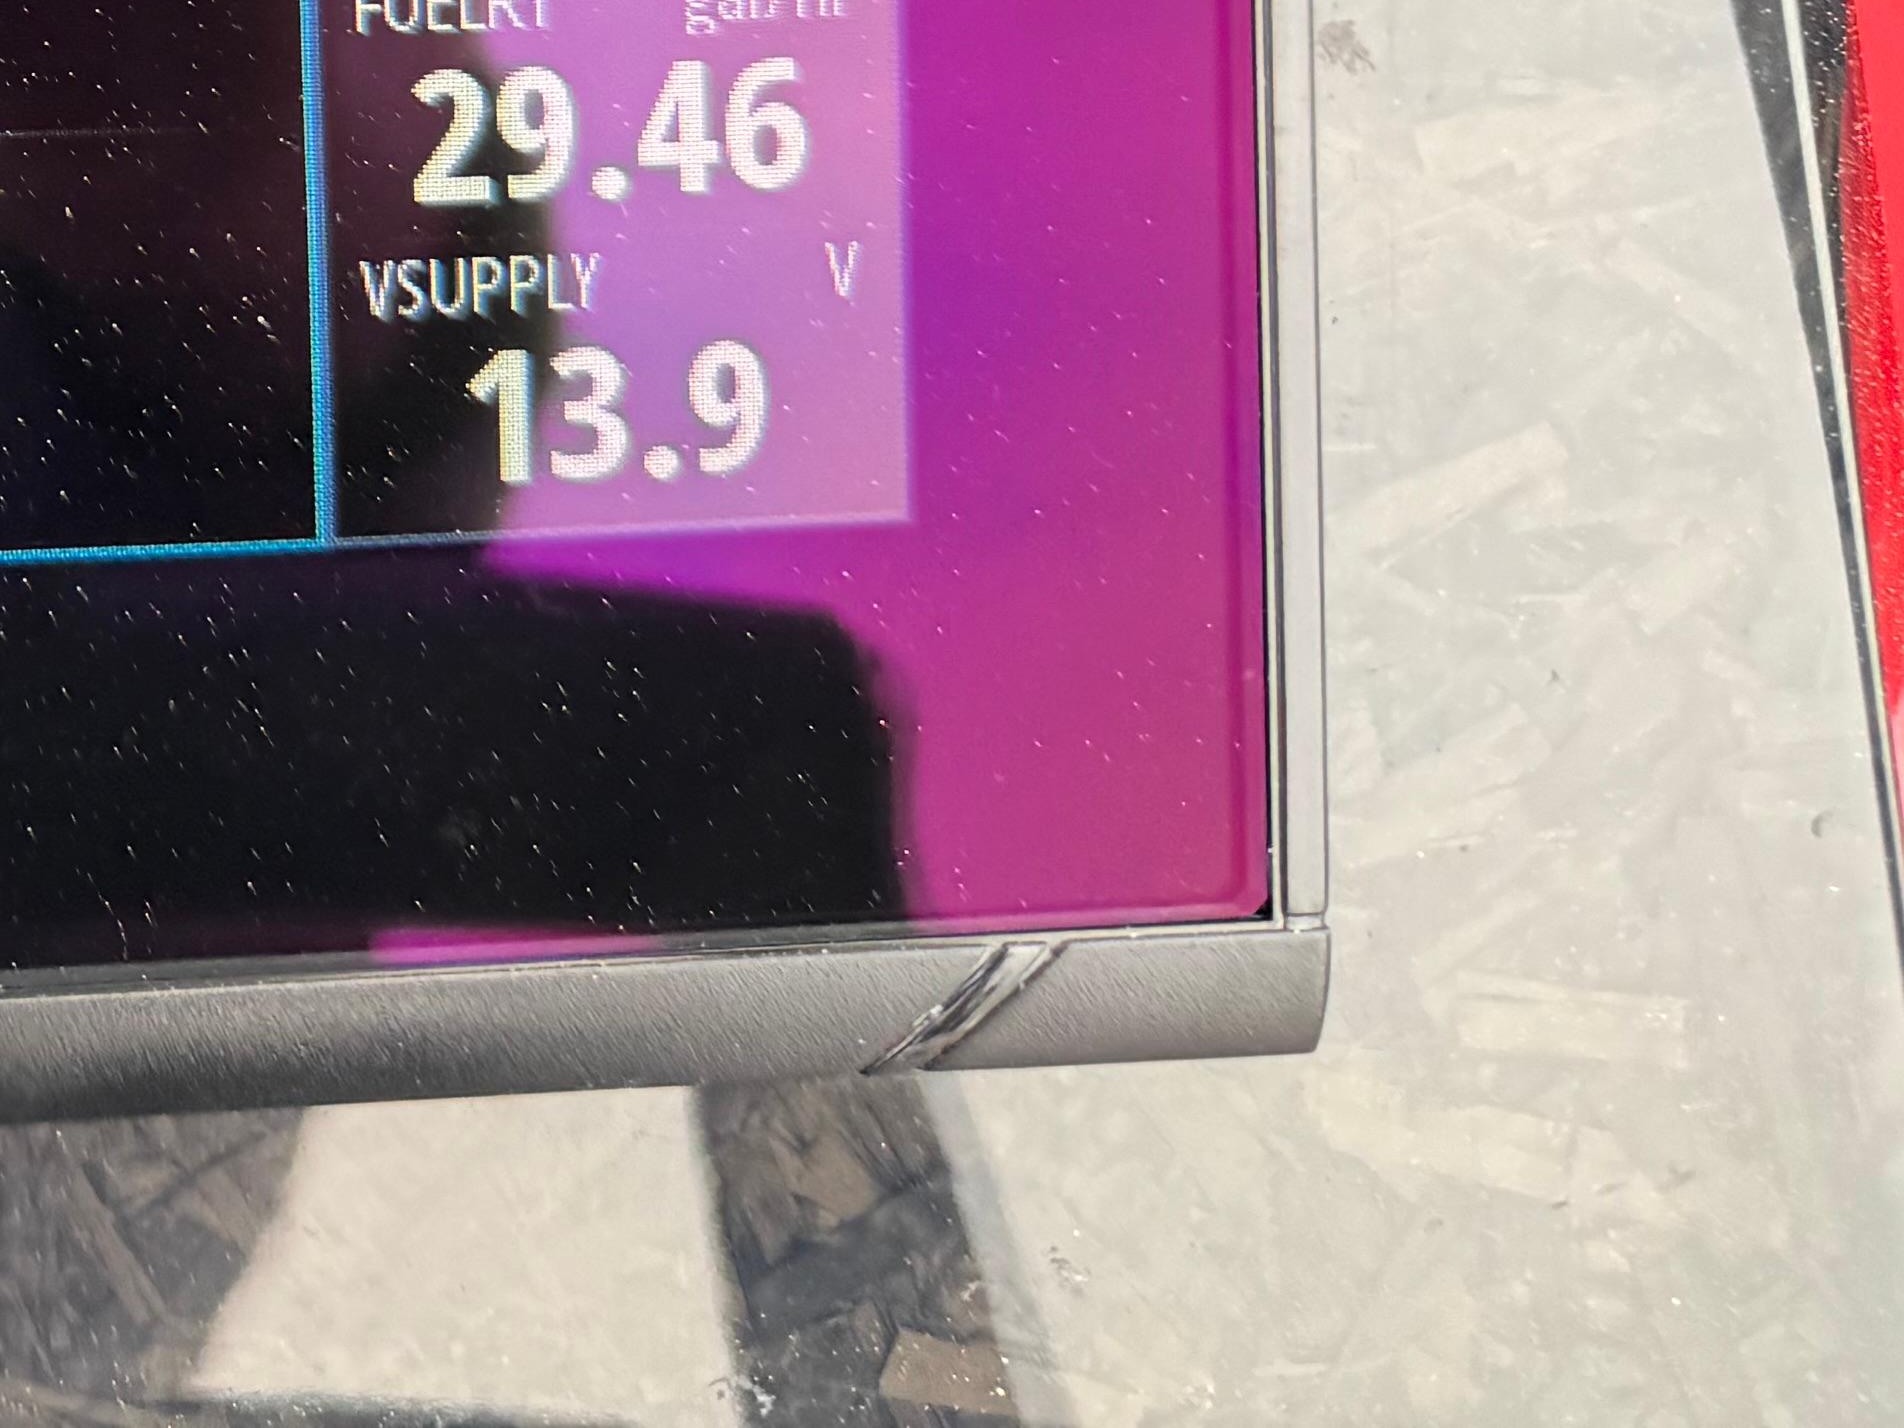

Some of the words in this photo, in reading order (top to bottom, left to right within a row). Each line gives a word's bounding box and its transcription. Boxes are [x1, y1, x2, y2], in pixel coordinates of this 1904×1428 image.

[411, 55, 809, 208] 29.46
[358, 251, 603, 322] VSUPPLY
[823, 239, 861, 302] V
[466, 339, 769, 488] 13.9
